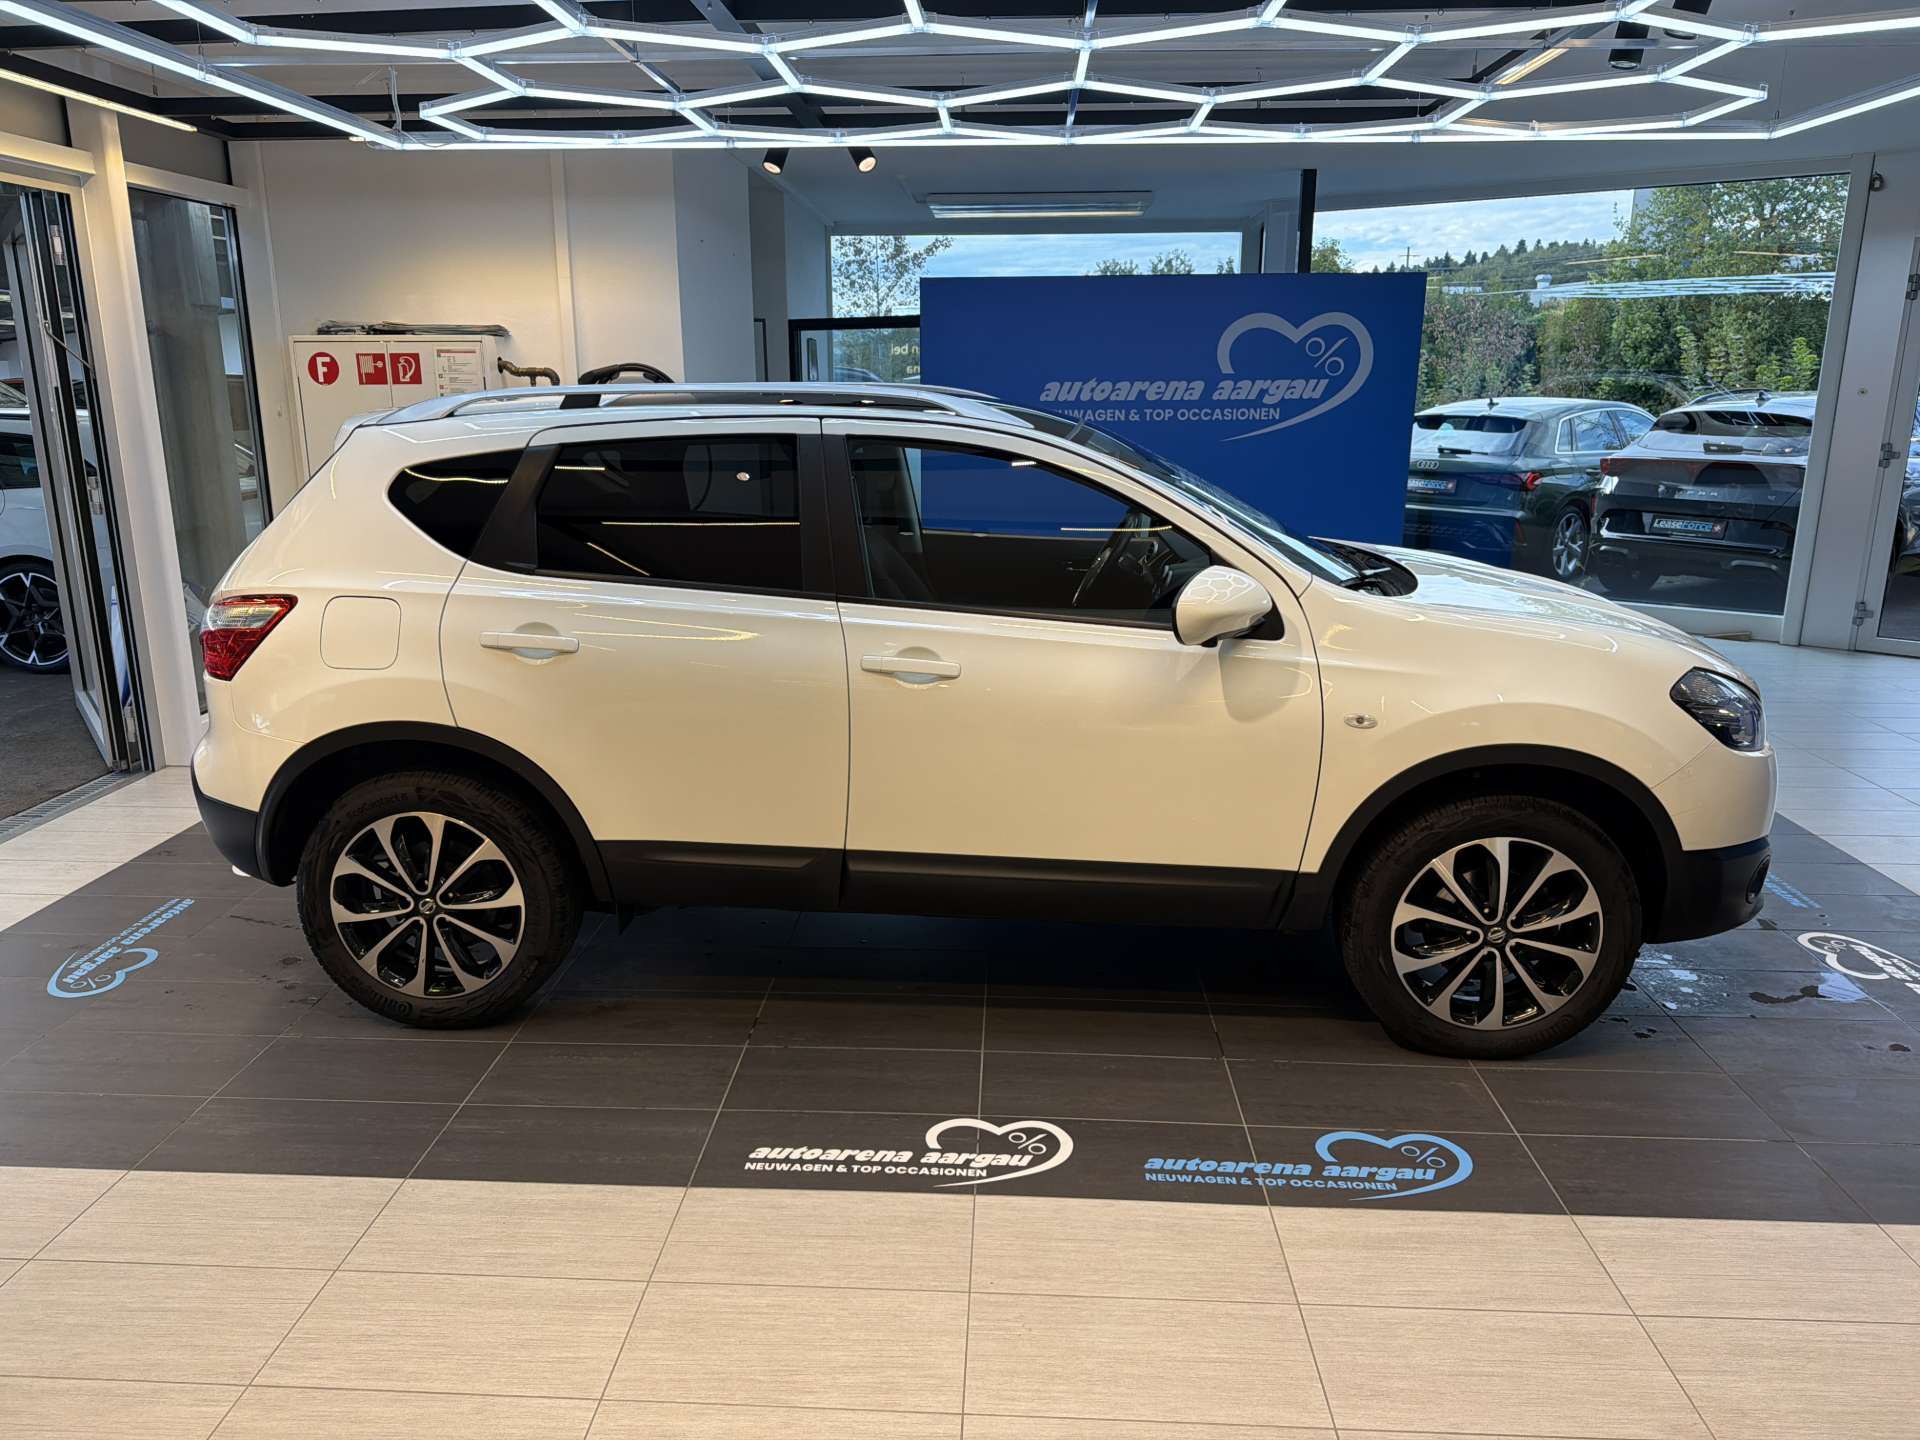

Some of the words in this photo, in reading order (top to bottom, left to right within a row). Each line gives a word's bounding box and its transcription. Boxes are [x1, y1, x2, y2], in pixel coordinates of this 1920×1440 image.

[315, 356, 330, 382] F
[1040, 377, 1205, 402] autoarena
[1212, 378, 1329, 405] aargau
[1057, 409, 1125, 421] WAGEN
[1128, 408, 1140, 421] &
[1143, 408, 1174, 421] TOP
[1177, 407, 1280, 421] OCCASIONEN
[1653, 519, 1713, 532] LeaseForce
[748, 1145, 914, 1163] autoarena
[920, 1148, 1033, 1168] aargau
[744, 1161, 835, 1173] NEUWAGEN
[837, 1164, 847, 1173] &
[851, 1164, 882, 1174] TOP
[885, 1165, 988, 1178] OCCASIONEN
[1144, 1157, 1312, 1176] autoarena
[1322, 1164, 1437, 1181] aargau
[1144, 1172, 1238, 1186] NEUWAGEN
[1241, 1176, 1252, 1186] &
[1253, 1176, 1291, 1188] TOP
[1293, 1178, 1398, 1192] OCCASIONEN
